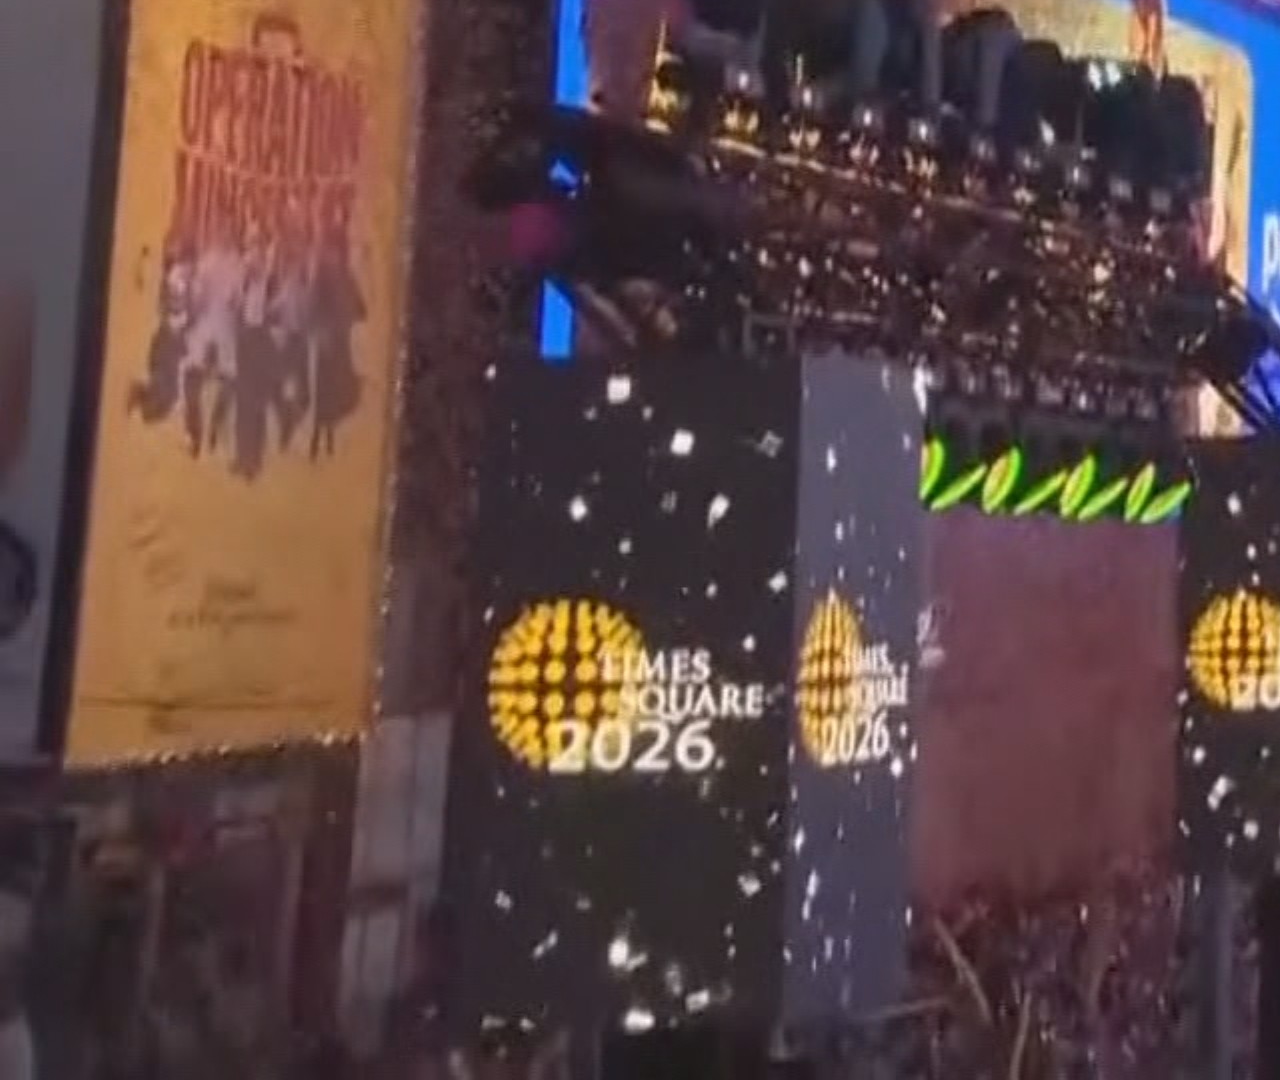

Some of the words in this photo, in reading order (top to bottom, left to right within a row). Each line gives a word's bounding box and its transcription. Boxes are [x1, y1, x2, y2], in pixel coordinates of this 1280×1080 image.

[598, 648, 712, 684] TIMES
[618, 683, 765, 724] SQUARE
[548, 719, 716, 773] 2026
[820, 707, 891, 767] 2026
